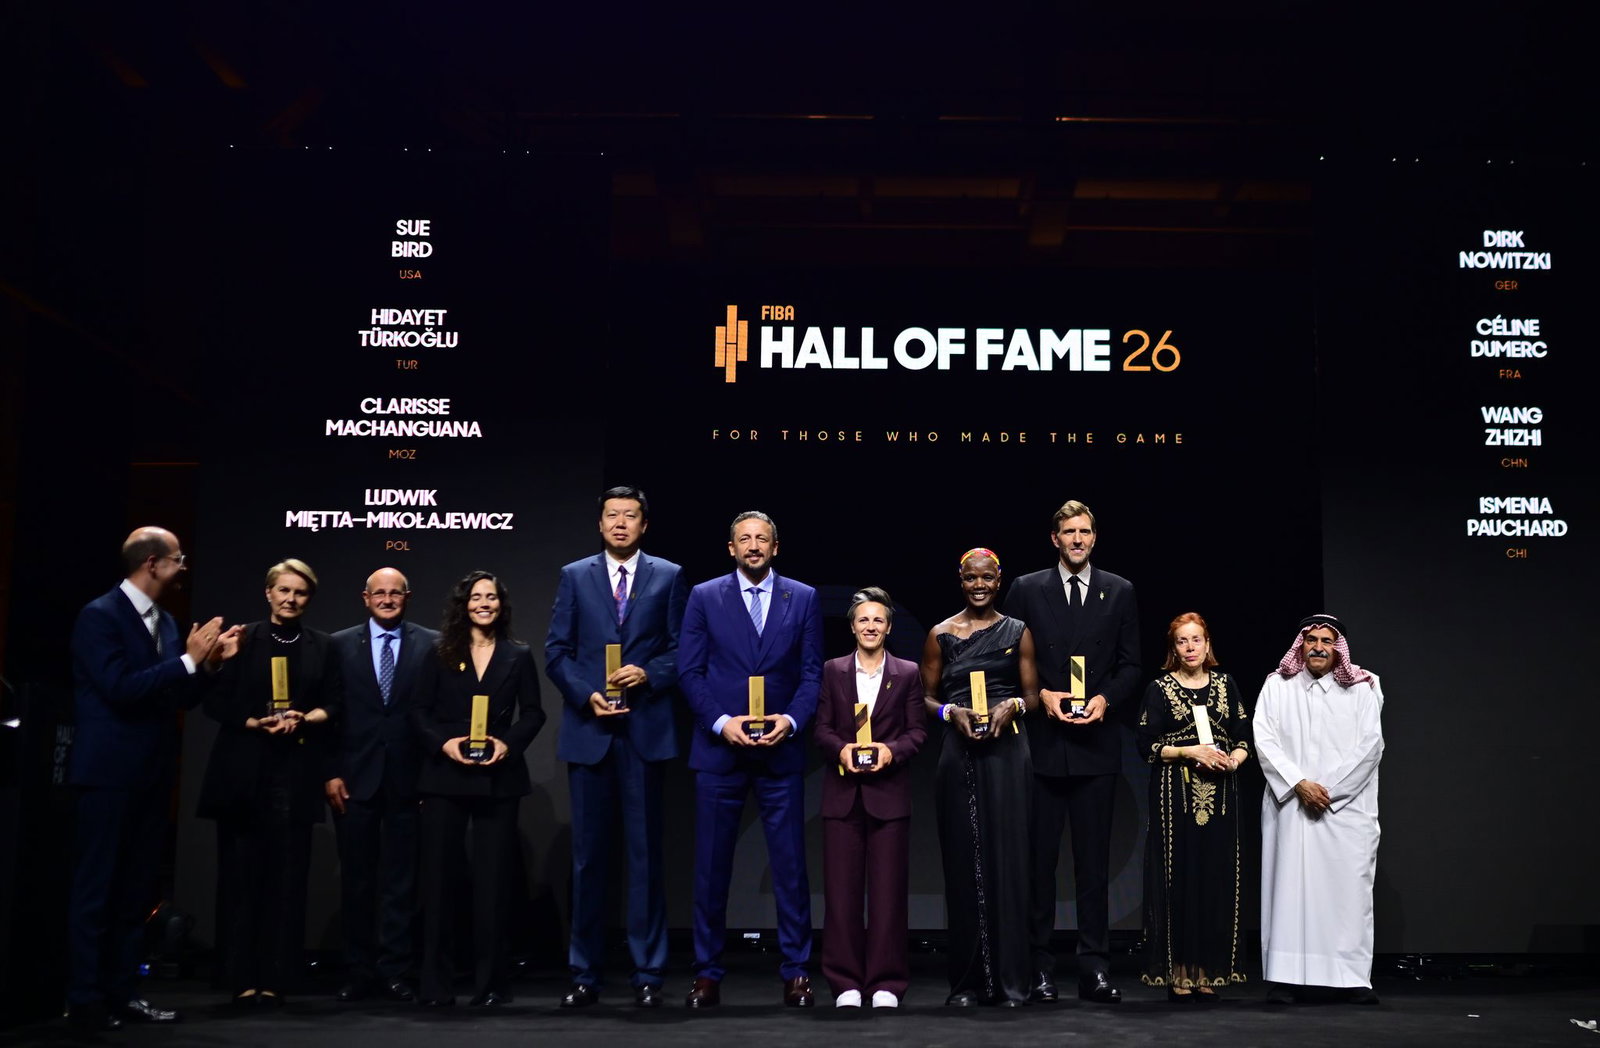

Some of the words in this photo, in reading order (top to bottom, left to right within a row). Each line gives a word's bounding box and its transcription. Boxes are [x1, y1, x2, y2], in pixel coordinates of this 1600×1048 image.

[396, 220, 430, 236] SUE
[1483, 230, 1525, 248] DIRK
[392, 241, 433, 257] BIRD
[1459, 251, 1551, 269] NOWITZKI
[400, 270, 421, 279] USA
[1495, 281, 1517, 290] GER
[371, 309, 447, 325] HIDAYET
[762, 305, 794, 320] FIBA
[1476, 314, 1540, 336] CÉLINE
[358, 327, 458, 348] TÜRKOĞLU
[761, 326, 888, 369] HALL
[894, 327, 965, 370] OF
[976, 328, 1110, 371] FAME
[1123, 330, 1180, 372] 26
[1471, 340, 1547, 358] DUMERC
[397, 360, 417, 369] TUR
[1500, 369, 1521, 378] FRA
[360, 398, 450, 415] CLARISSE
[1481, 406, 1543, 424] WANG
[326, 419, 482, 437] MACHANGUANA
[713, 430, 757, 440] FOR
[782, 430, 861, 441] THOSE
[887, 432, 938, 441] WHO
[962, 432, 1025, 442] MADE
[1050, 433, 1092, 443] THE
[1117, 433, 1182, 443] GAME
[1485, 429, 1541, 446] ZHIZHI
[389, 450, 416, 459] MOZ
[1502, 458, 1527, 467] CHN
[365, 489, 437, 506] LUDWIK
[1480, 497, 1553, 514] ISMENIA
[1467, 519, 1568, 536] PAUCHARD
[386, 541, 410, 550] POL
[1507, 548, 1526, 558] CHI
